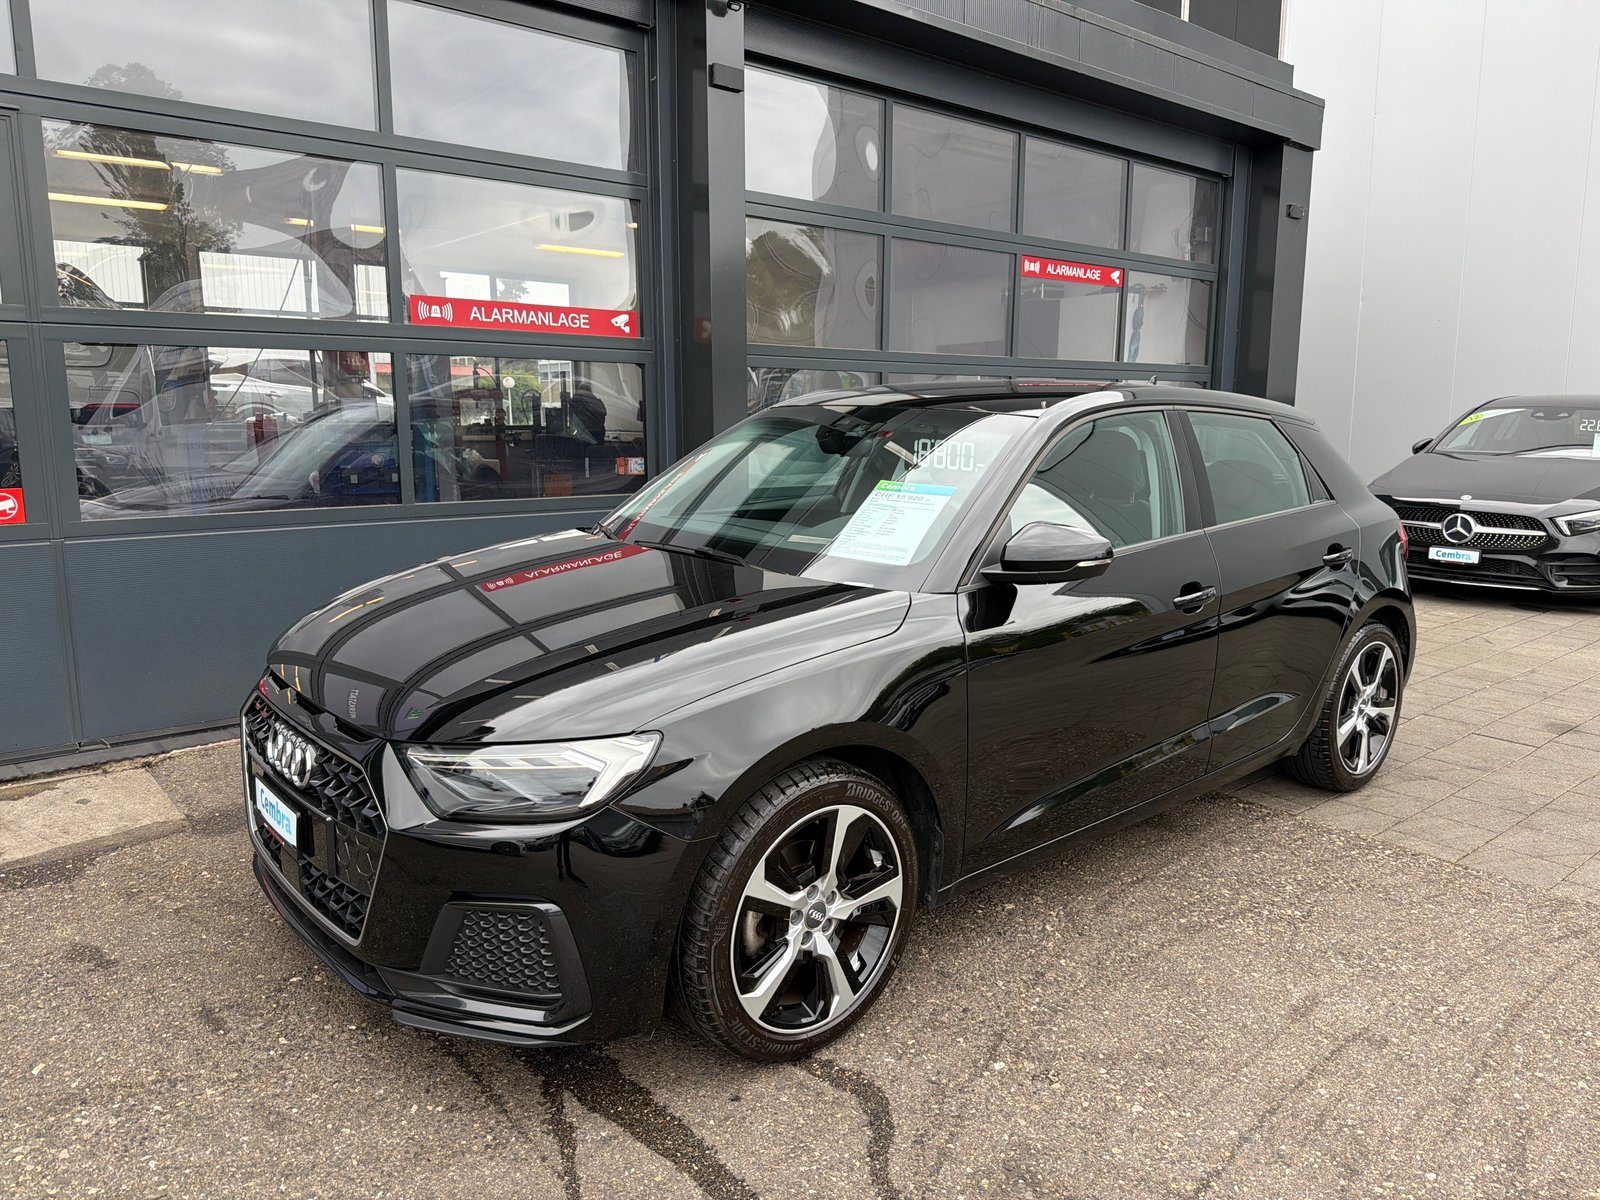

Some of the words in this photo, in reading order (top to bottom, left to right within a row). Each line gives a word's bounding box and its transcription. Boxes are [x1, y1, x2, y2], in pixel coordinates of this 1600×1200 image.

[1046, 263, 1101, 281] ALARMANLAGE
[469, 306, 590, 329] ALARMANLAGE
[880, 483, 916, 491] Cembra
[1436, 549, 1472, 561] Cembra
[260, 788, 292, 835] Cembra
